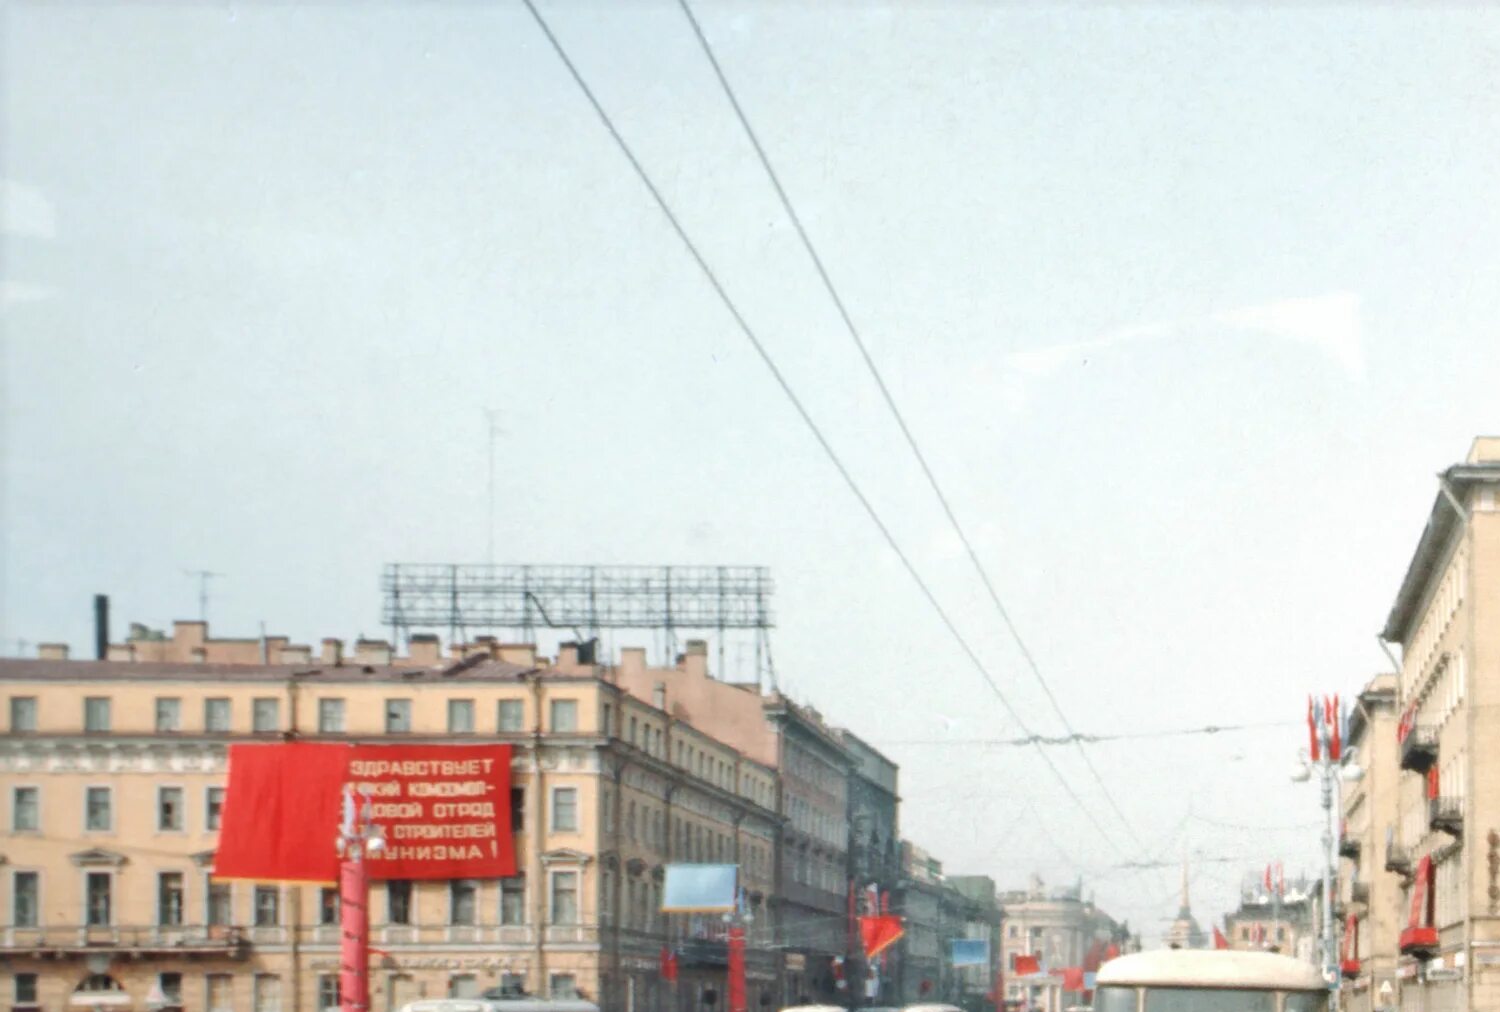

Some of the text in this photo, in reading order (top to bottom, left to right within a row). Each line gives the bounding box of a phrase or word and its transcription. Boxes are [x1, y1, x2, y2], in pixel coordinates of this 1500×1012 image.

[351, 759, 494, 777] ЗДРАВСТВУЕТ
[433, 802, 496, 818] ОТРЯД
[394, 823, 496, 839] СТРОИТЕЛЕЙ
